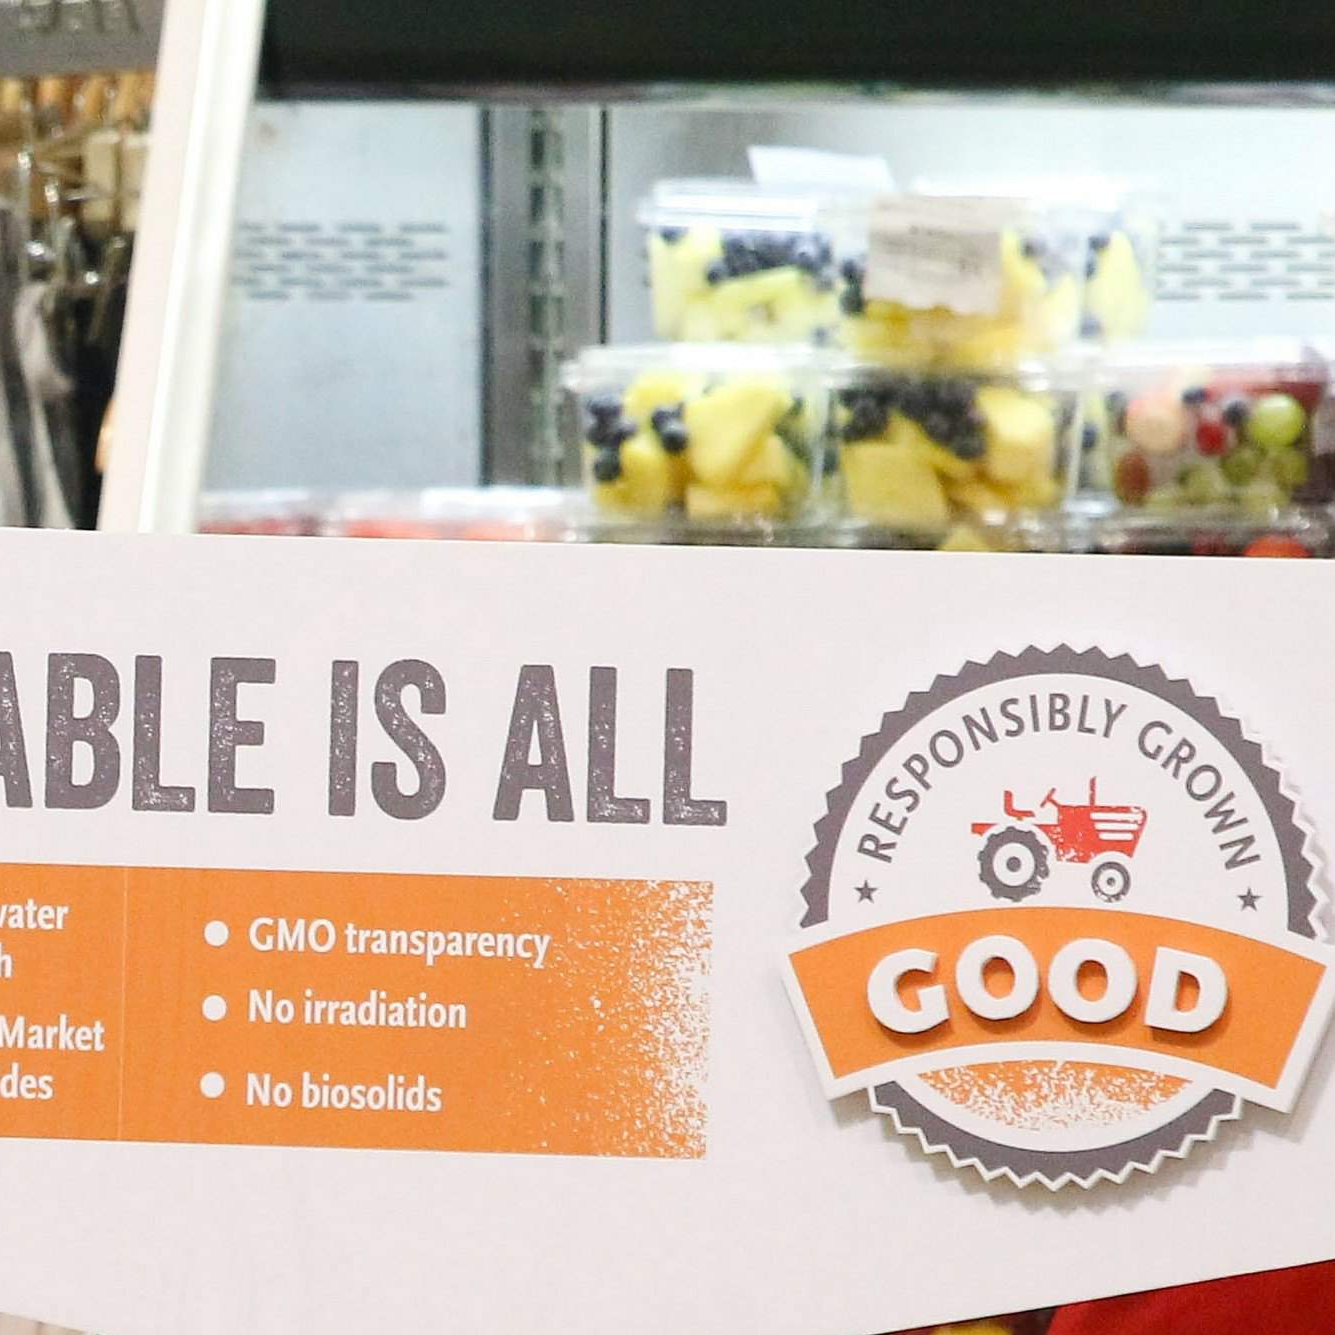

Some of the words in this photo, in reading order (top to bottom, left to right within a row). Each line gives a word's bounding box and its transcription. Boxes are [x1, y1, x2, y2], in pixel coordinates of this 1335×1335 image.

[328, 659, 446, 821] IS
[492, 664, 727, 826] ALL
[857, 693, 1129, 864] RESPONSIBLY
[1137, 719, 1262, 872] GROWN
[248, 916, 337, 954] GMO
[344, 922, 551, 969] transparency
[248, 988, 295, 1025] No
[304, 988, 468, 1029] irradiation
[866, 934, 1229, 1034] GOOD
[245, 1072, 293, 1108] No
[301, 1072, 443, 1113] biosolids
